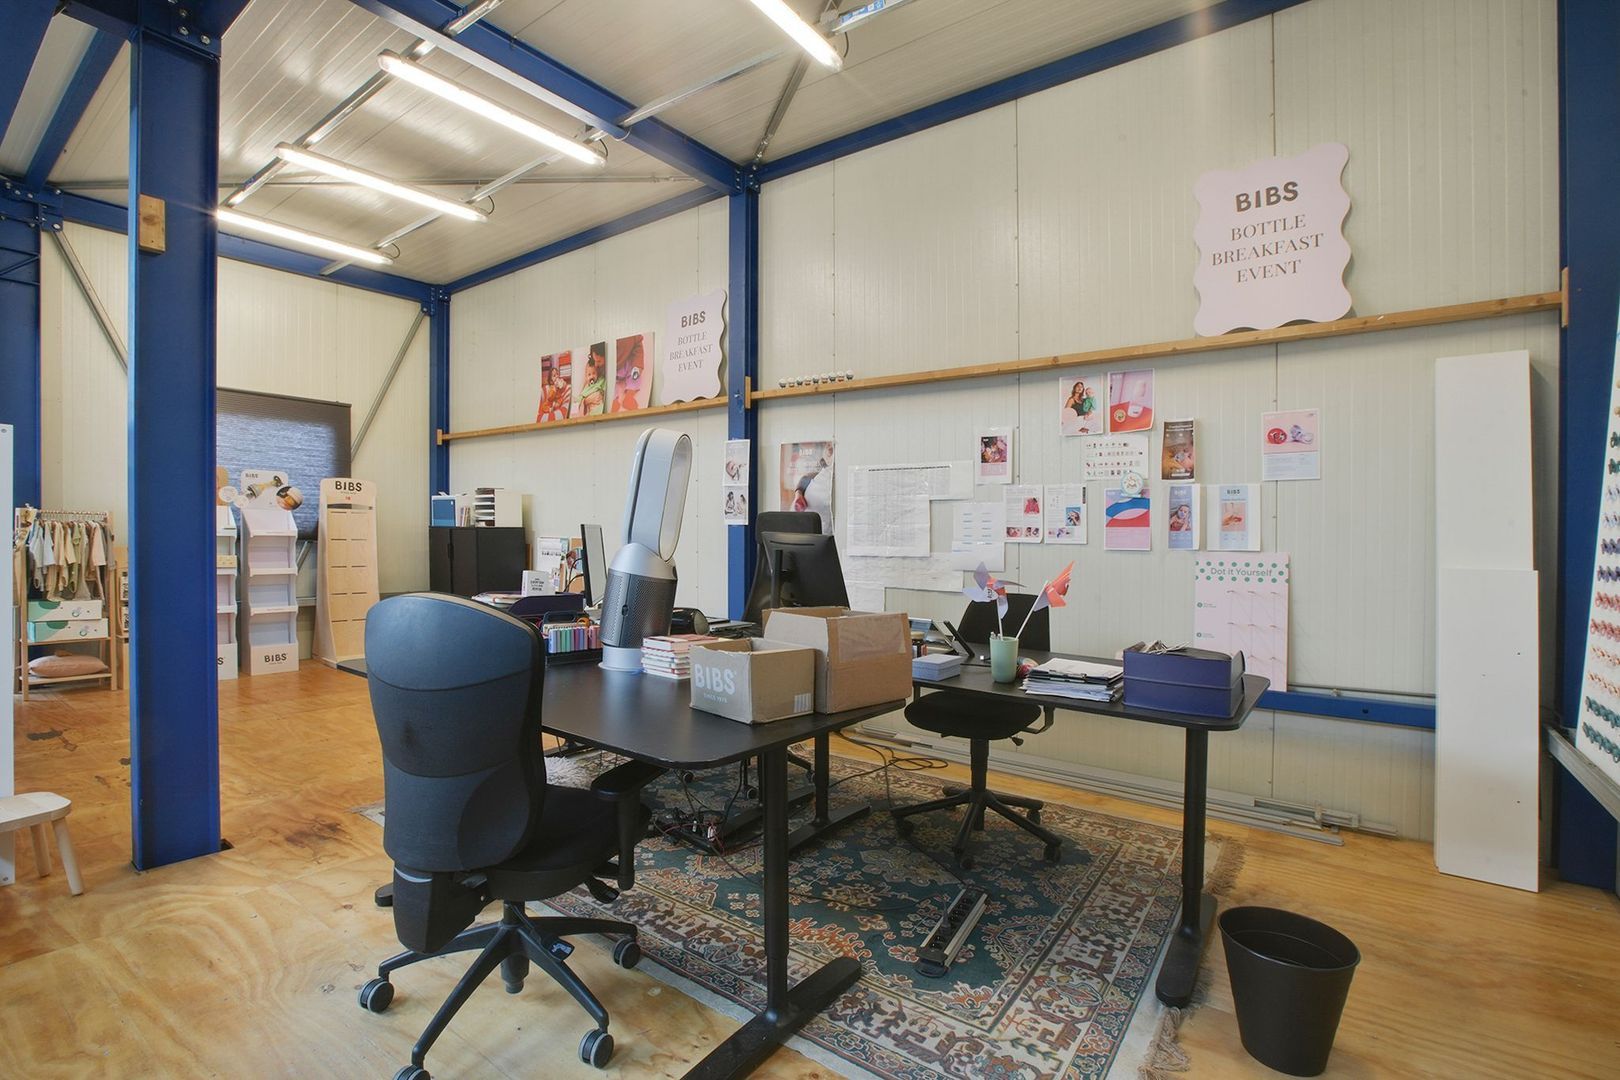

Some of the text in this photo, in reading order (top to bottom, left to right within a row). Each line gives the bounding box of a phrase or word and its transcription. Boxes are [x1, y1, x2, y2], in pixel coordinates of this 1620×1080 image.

[1235, 181, 1298, 213] BIBS
[1231, 214, 1306, 241] BOTTLE
[1212, 233, 1324, 266] BREAKFAST
[1237, 260, 1301, 283] EVENT
[681, 311, 706, 328] BIBS
[677, 332, 707, 346] BOTTLE
[669, 344, 713, 361] BREAKFAST
[678, 360, 704, 373] EVENT
[335, 480, 362, 492] BIBS
[1210, 567, 1272, 577] Dot it Yourself
[264, 653, 287, 663] BIBS
[694, 663, 736, 695] BIBS
